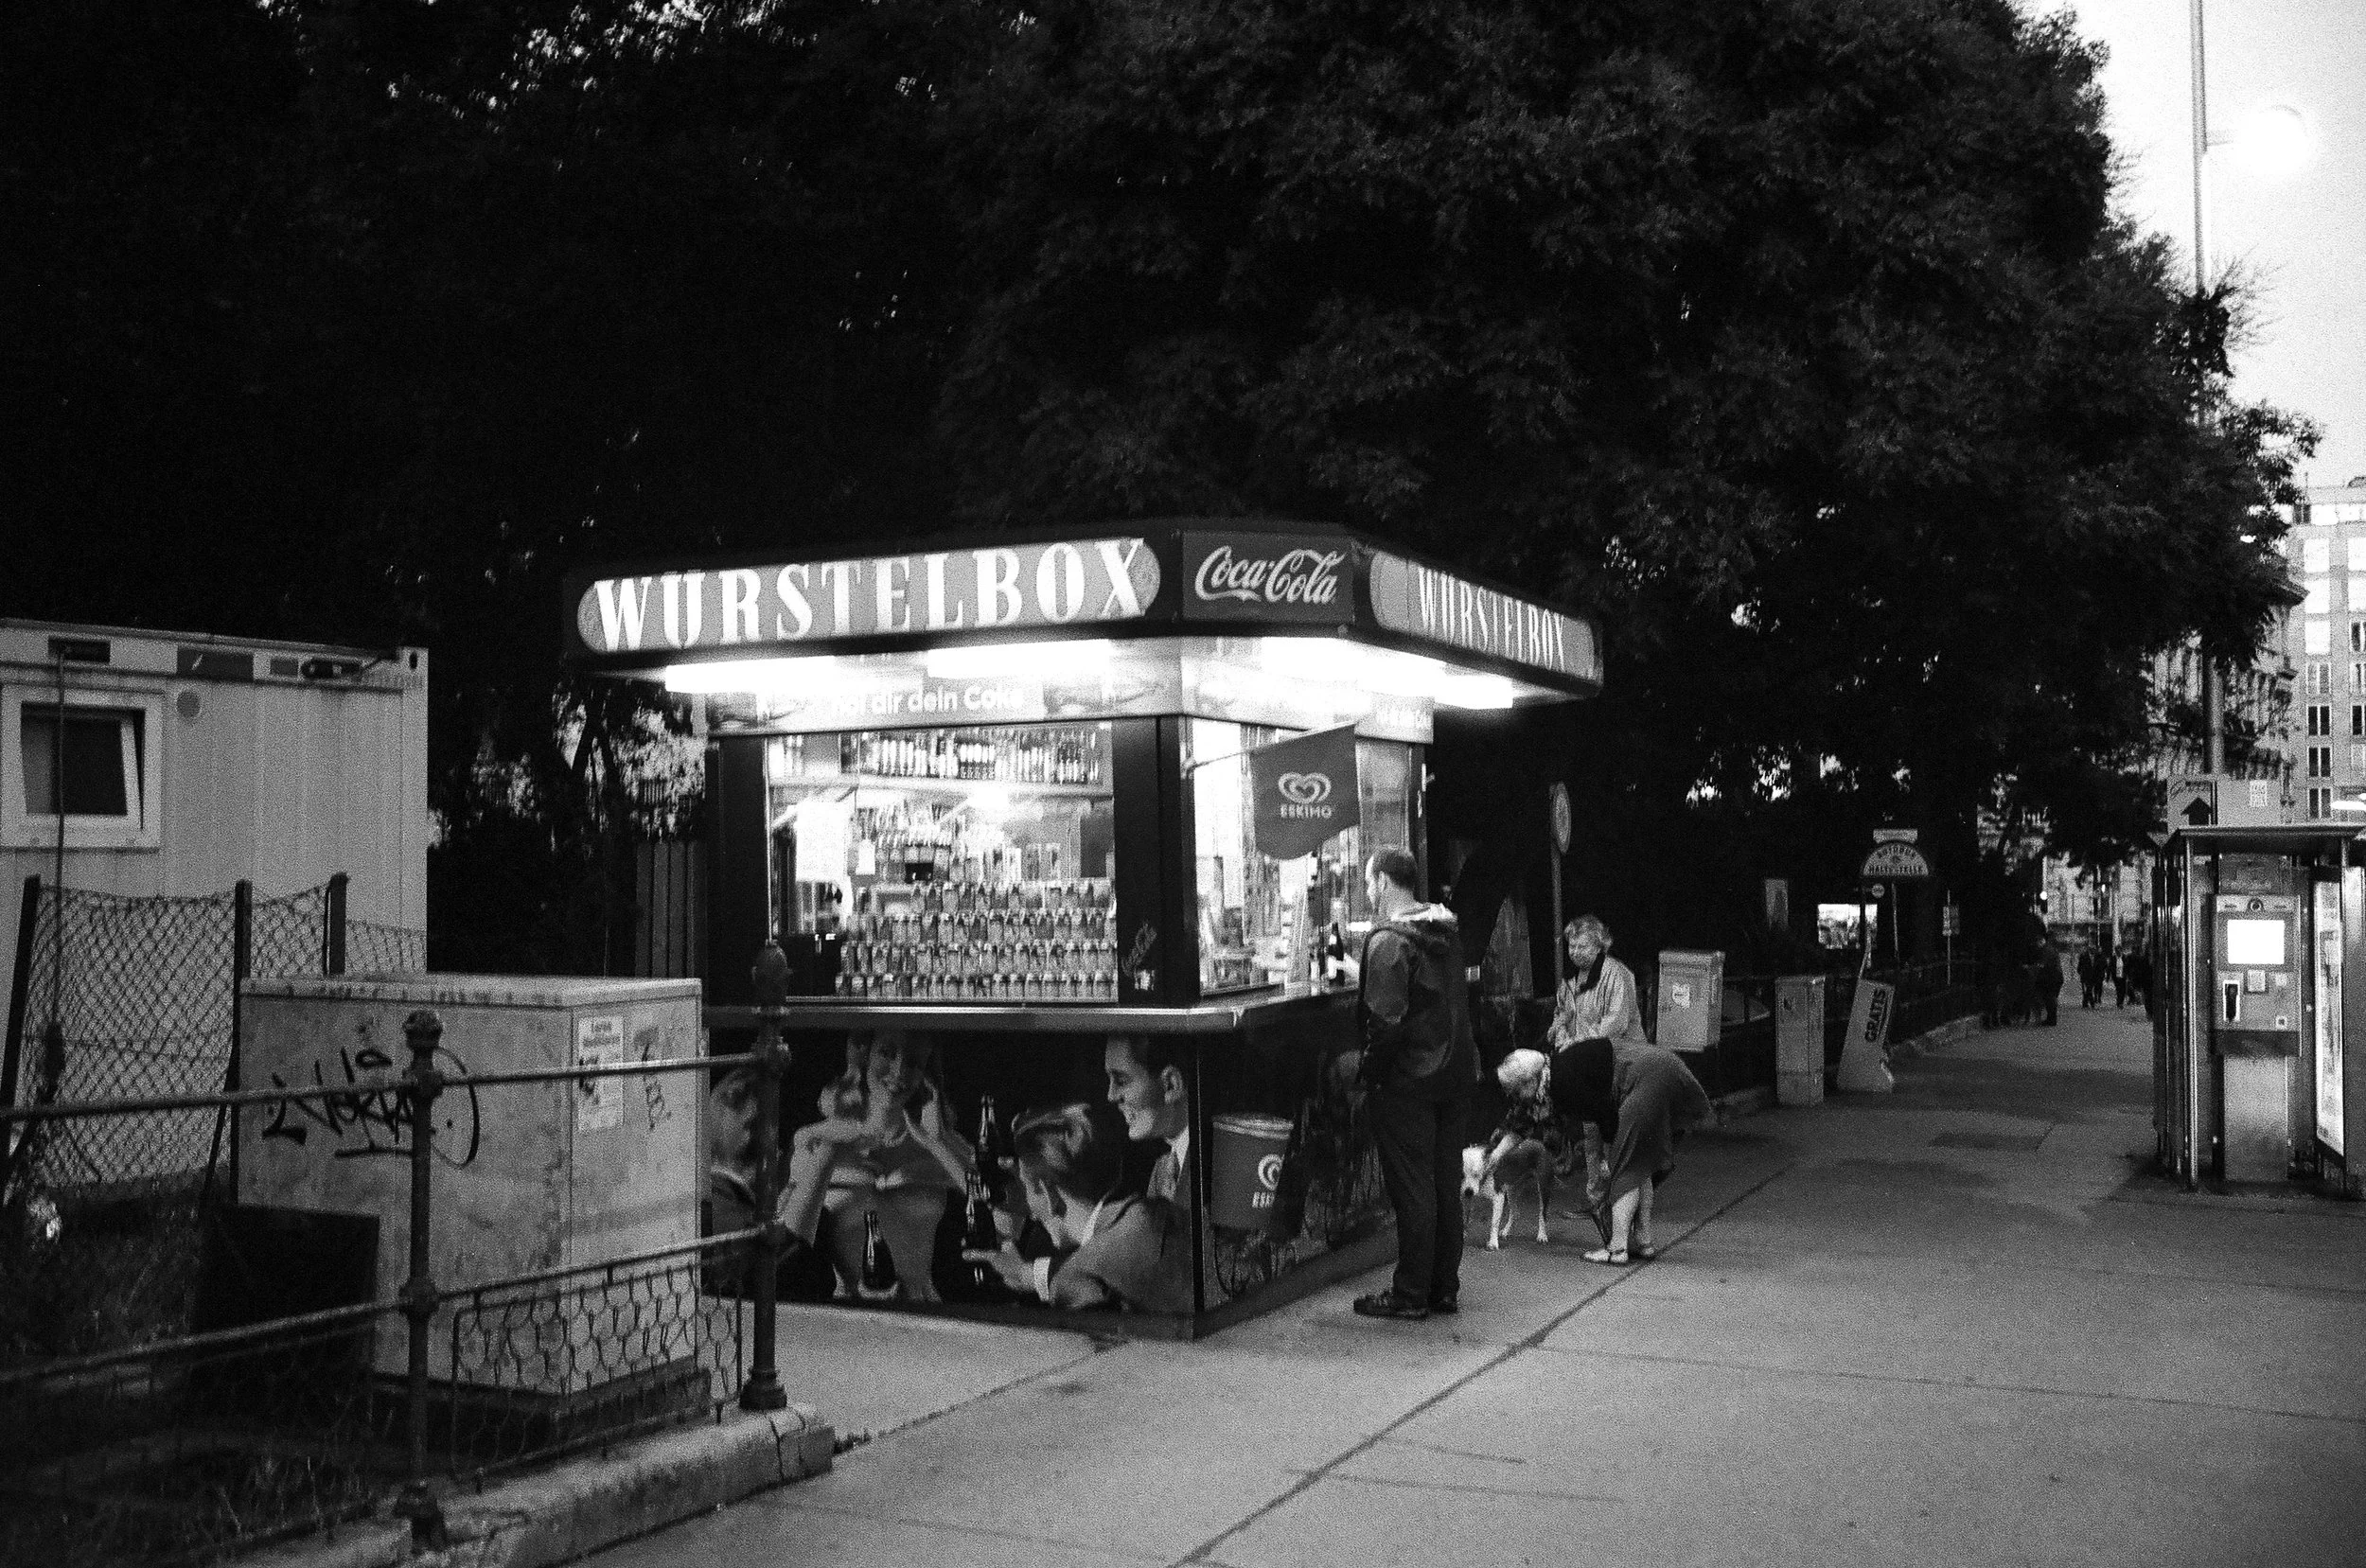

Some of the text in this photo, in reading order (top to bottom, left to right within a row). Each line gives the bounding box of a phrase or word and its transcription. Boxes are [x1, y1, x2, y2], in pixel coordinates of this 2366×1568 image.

[1193, 544, 1347, 604] Coca-Cola
[872, 690, 902, 714] dir
[907, 684, 958, 714] dein
[1280, 803, 1333, 819] ESKIMO
[1864, 987, 1886, 1043] GRATIS
